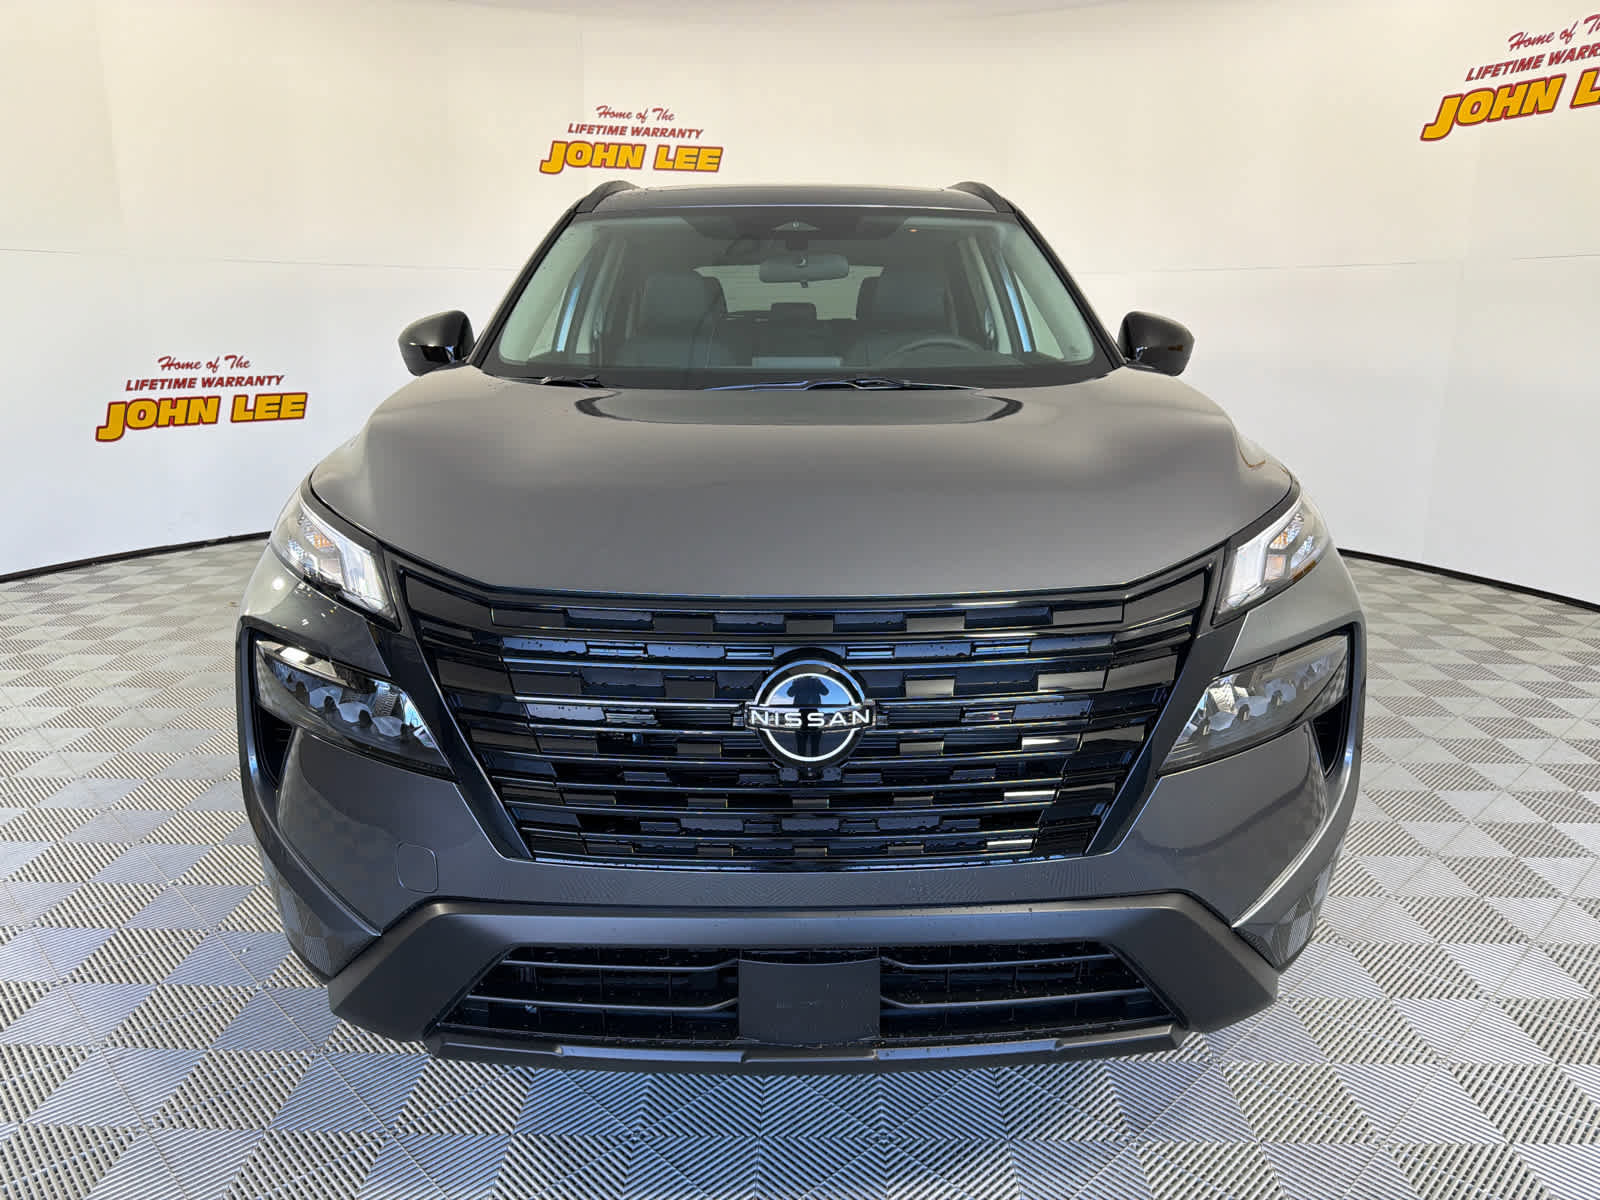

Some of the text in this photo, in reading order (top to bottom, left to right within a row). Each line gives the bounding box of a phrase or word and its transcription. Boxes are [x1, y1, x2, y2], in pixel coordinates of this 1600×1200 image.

[1508, 31, 1555, 51] Home
[1559, 20, 1579, 44] of
[1465, 43, 1600, 81] LIFETIME WARR
[596, 105, 675, 123] Home of The
[1420, 67, 1600, 141] JOHN L
[567, 123, 704, 139] LIFETIME WARRANTY
[539, 140, 724, 174] JOHN LEE
[157, 354, 251, 373] Home of The
[125, 375, 285, 391] LIFETIME WARRANTY
[95, 392, 308, 443] JOHN LEE
[750, 709, 870, 727] NISSAN
